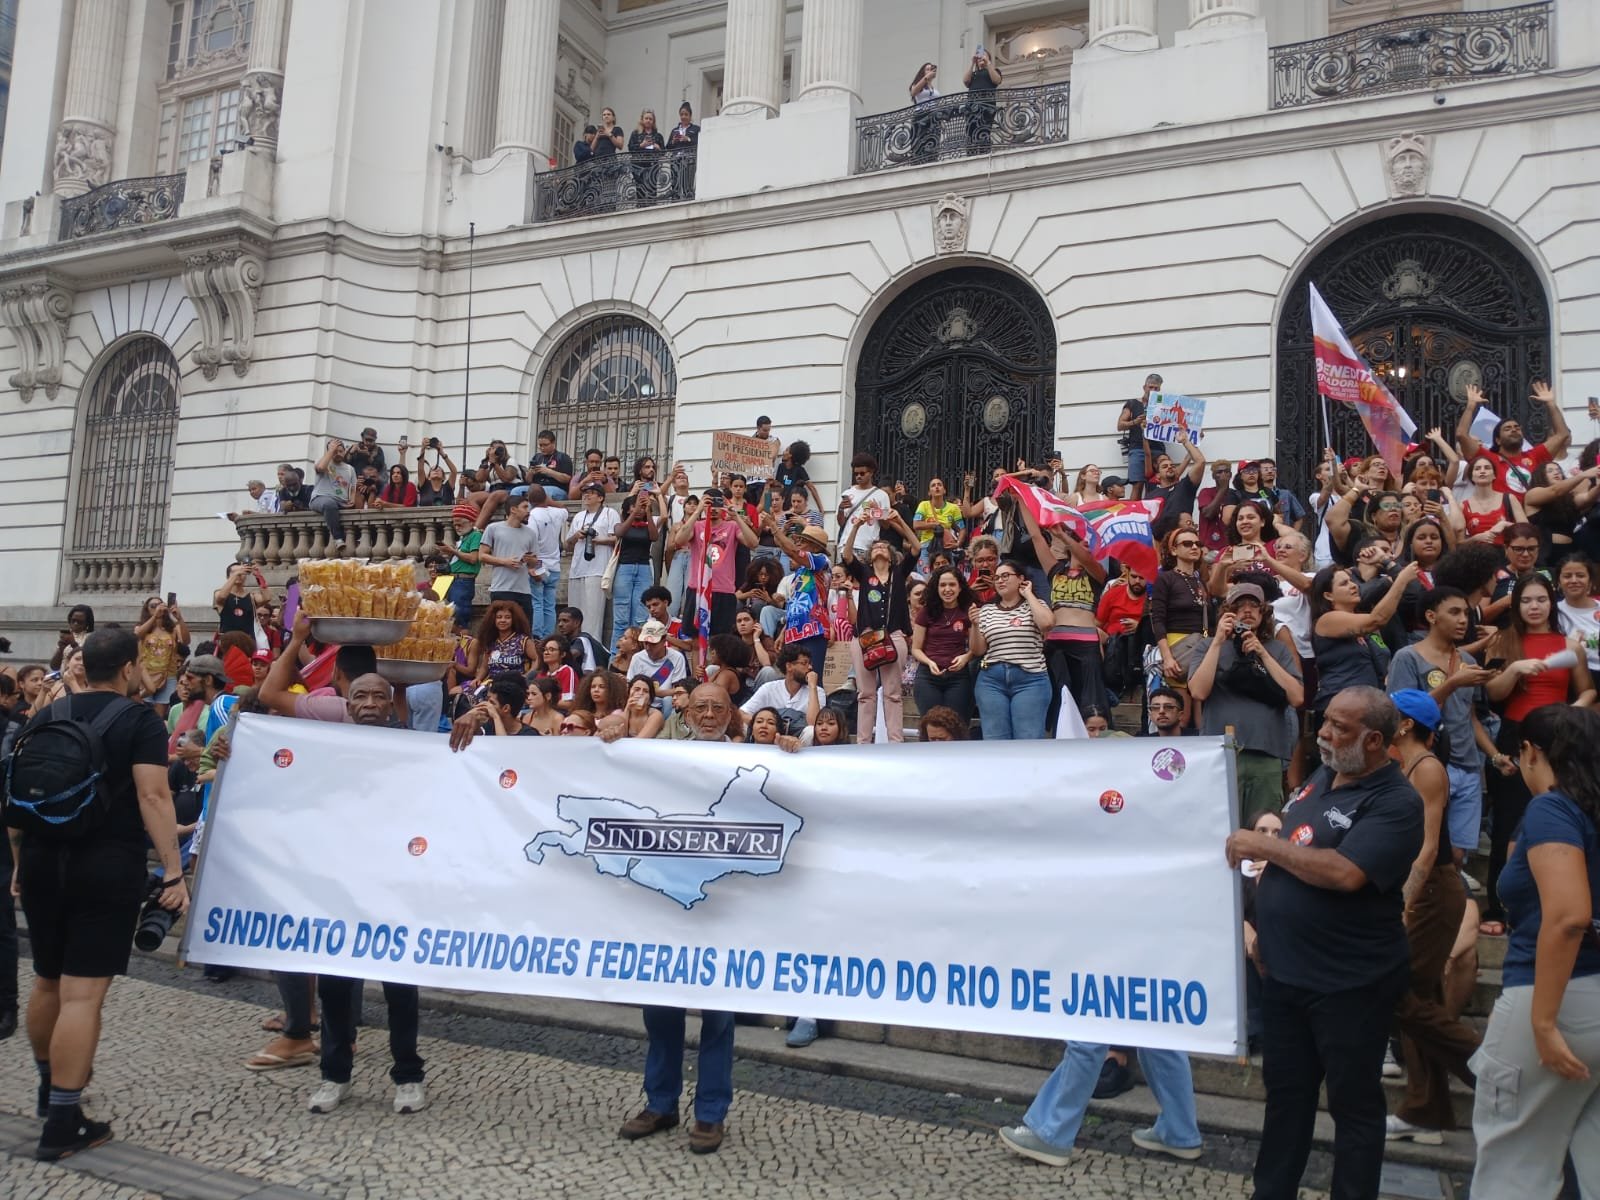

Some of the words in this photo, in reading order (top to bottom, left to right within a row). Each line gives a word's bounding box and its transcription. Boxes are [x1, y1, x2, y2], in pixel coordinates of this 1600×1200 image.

[1316, 373, 1360, 388] ENADORA
[735, 436, 770, 450] QUEREMOS
[718, 442, 729, 450] UM
[732, 444, 773, 460] PRESIDENTE
[724, 452, 738, 462] QUE
[742, 456, 765, 466] CHAMA
[203, 906, 347, 956] SINDICATO
[352, 921, 409, 962] DOS
[413, 927, 581, 976] SERVIDORES
[586, 939, 717, 987] FEDERAIS
[724, 947, 766, 990] NO
[773, 951, 887, 999] ESTADO
[896, 959, 937, 1004] DO
[946, 962, 1001, 1009] RIO
[1010, 966, 1052, 1014] DE
[1061, 971, 1208, 1027] JANEIRO
